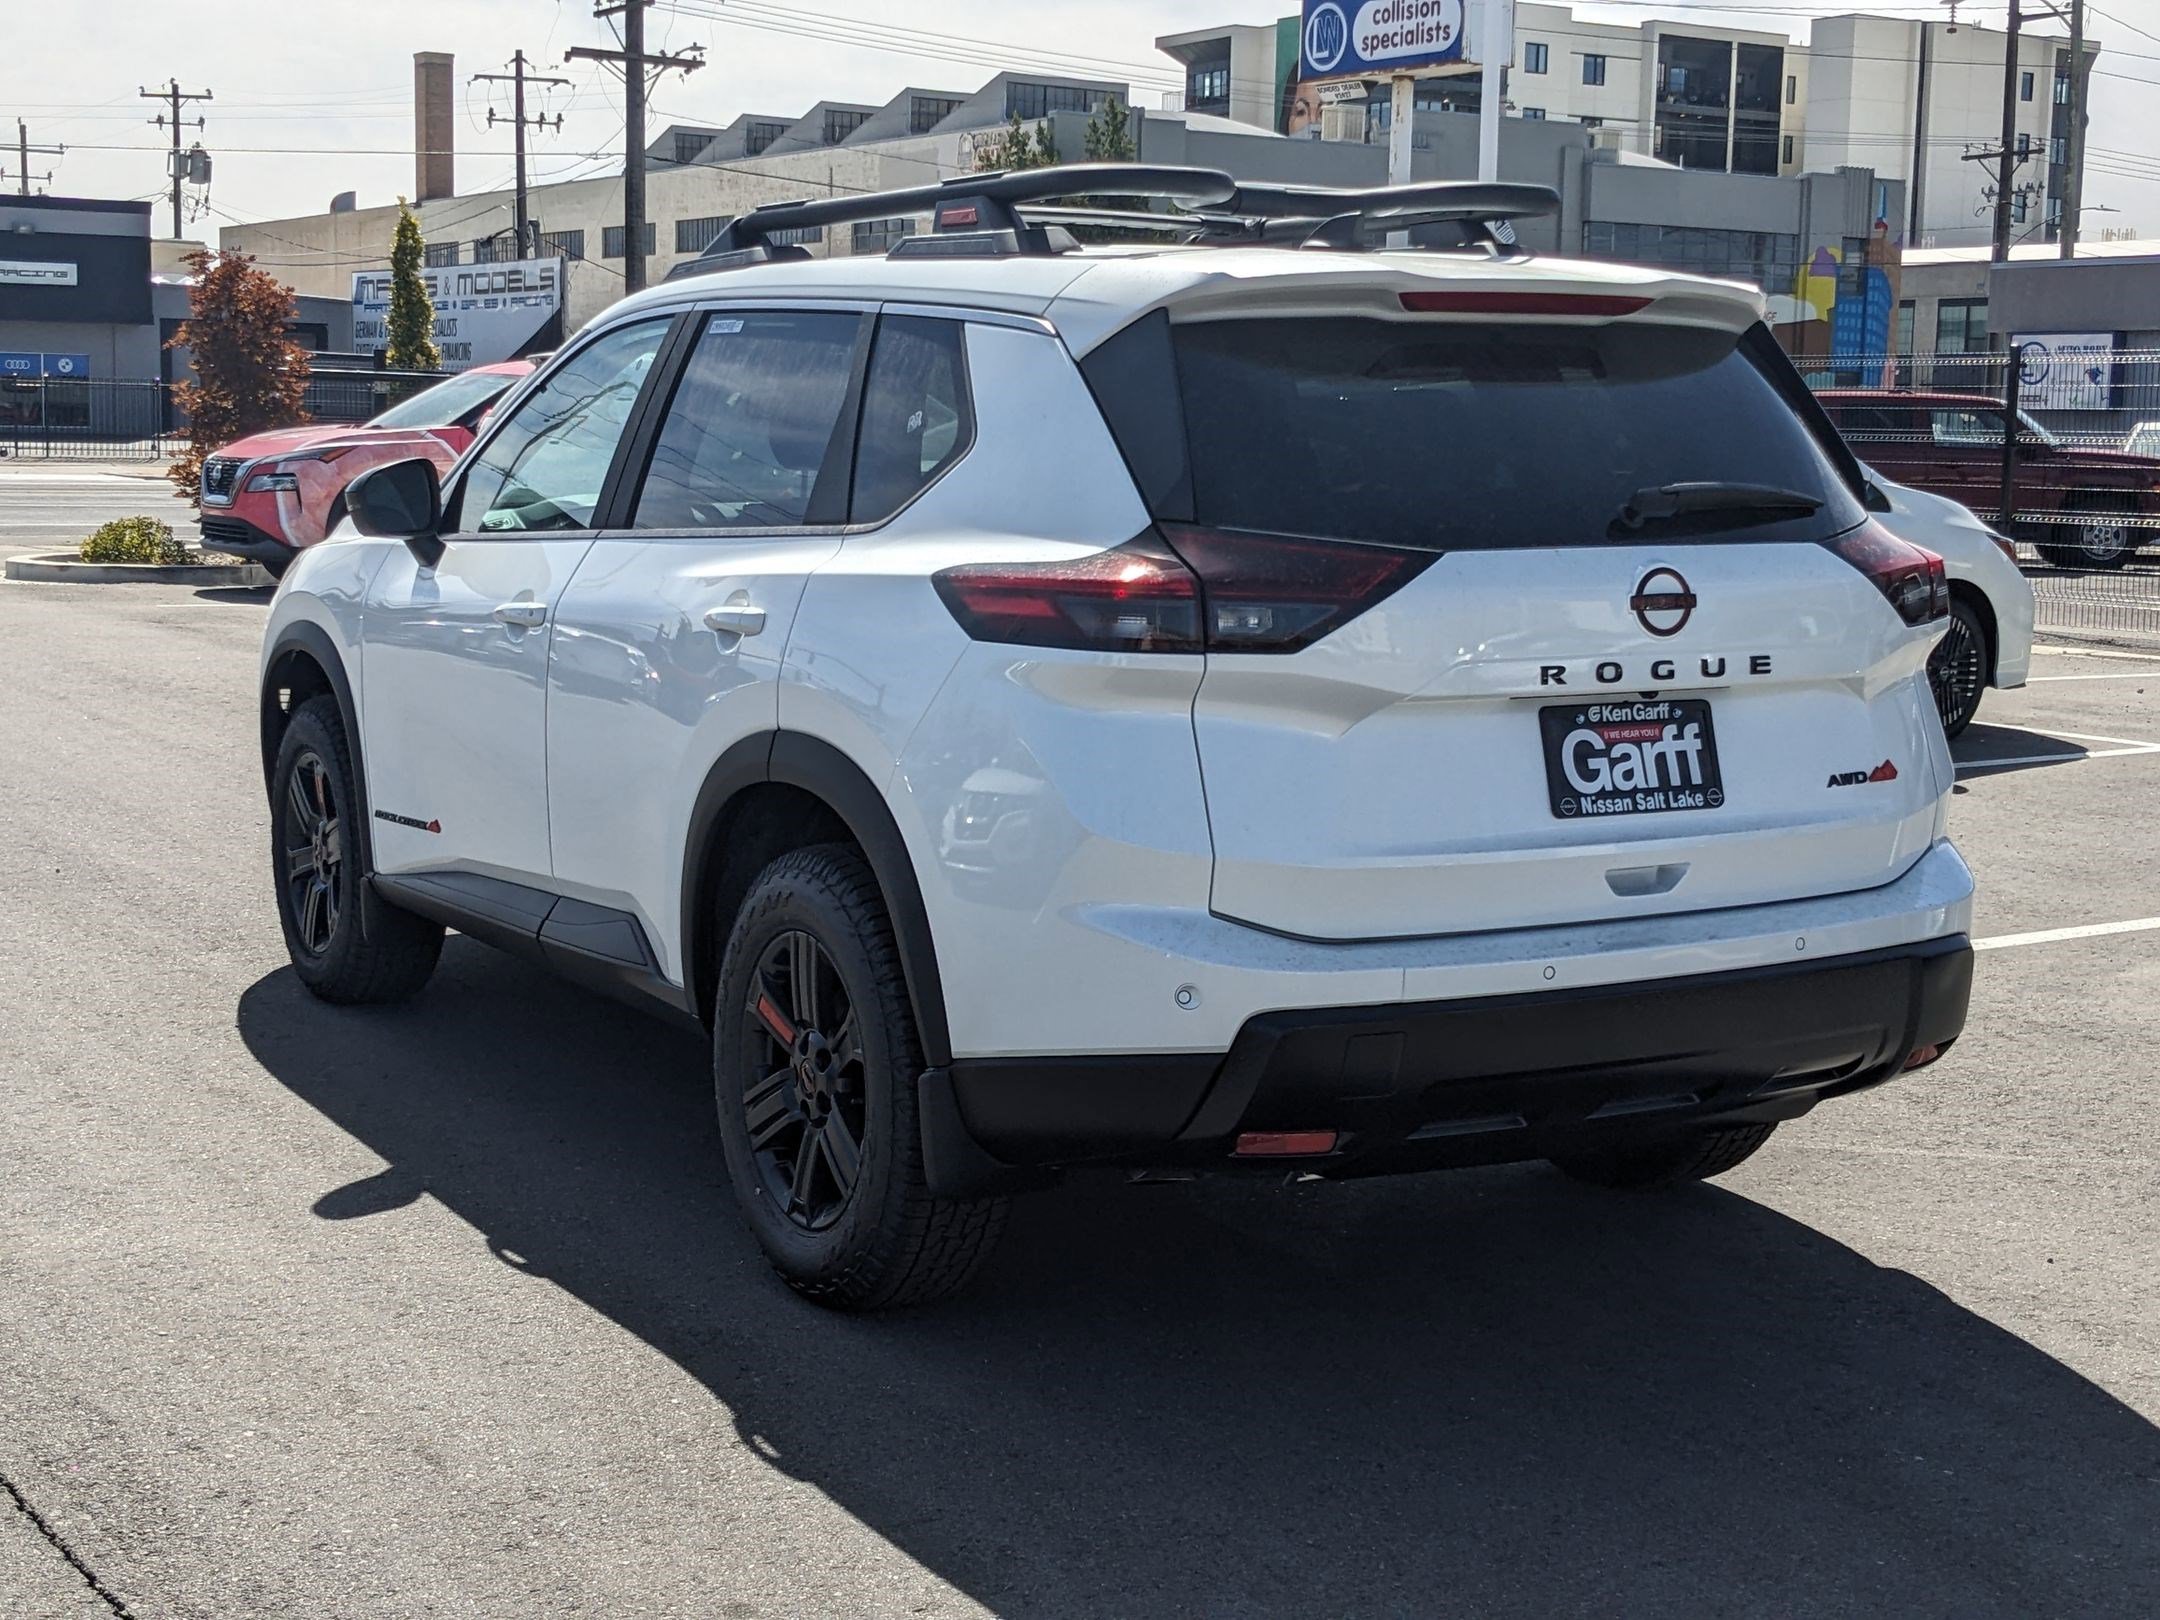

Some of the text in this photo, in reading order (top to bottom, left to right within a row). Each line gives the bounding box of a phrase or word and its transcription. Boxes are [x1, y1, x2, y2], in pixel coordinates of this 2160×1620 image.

[1372, 0, 1441, 26] collision
[1361, 21, 1451, 57] specialists
[457, 267, 554, 295] MODELS
[355, 320, 378, 339] GERMAN
[441, 342, 472, 361] FINANCING
[1540, 656, 1772, 685] ROGUE
[1602, 703, 1670, 722] Ken Garff
[1609, 729, 1654, 739] WE HEAR YOU
[1562, 722, 1703, 794] Garff
[1826, 770, 1868, 788] AWD
[1580, 789, 1704, 815] Nissan Salt Lake
